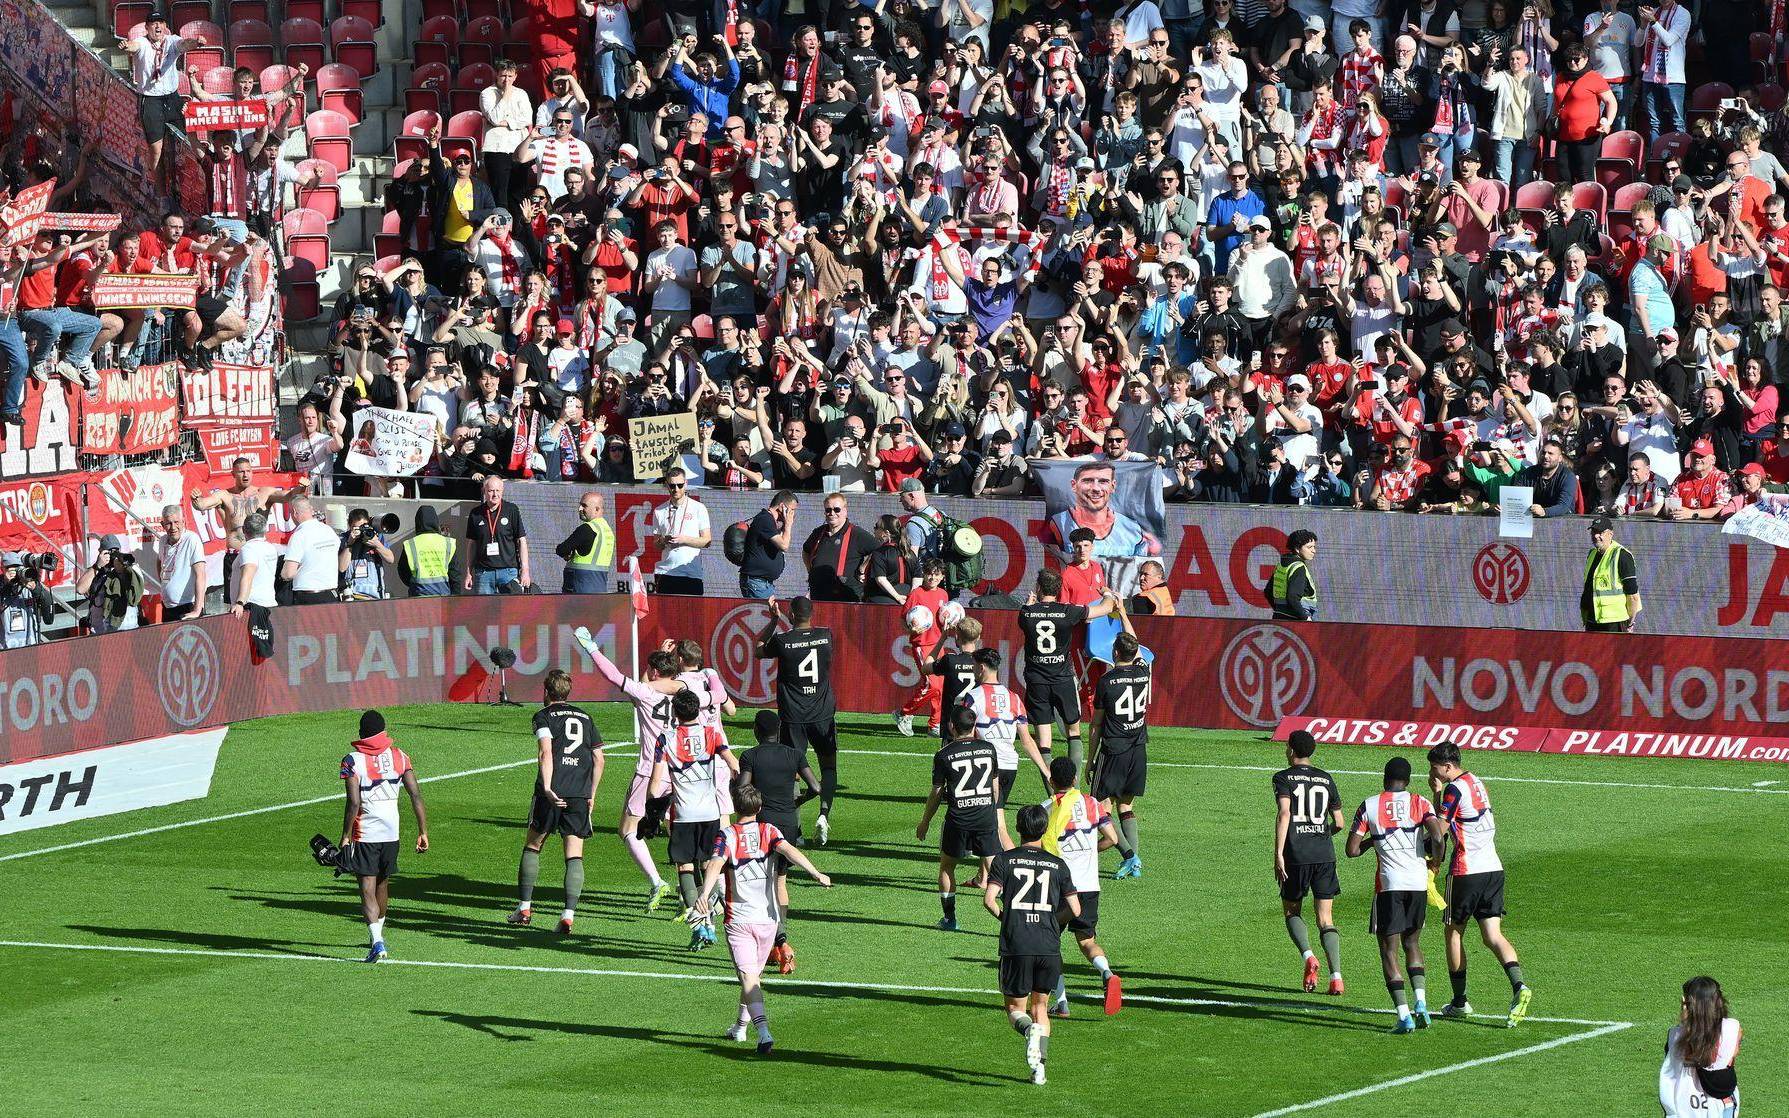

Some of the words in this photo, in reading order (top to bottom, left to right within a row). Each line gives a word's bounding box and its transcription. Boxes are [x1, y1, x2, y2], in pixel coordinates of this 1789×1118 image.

[185, 116, 219, 127] IMMER
[244, 114, 265, 123] UNS
[97, 293, 134, 305] IMMER
[137, 292, 195, 305] ANWESEND
[185, 369, 272, 417] COLEGIO
[85, 411, 118, 449] RED
[211, 430, 229, 447] LOVE
[633, 417, 680, 437] JAMAL
[636, 446, 667, 459] Trikot
[288, 623, 615, 687] PLATINUM
[1035, 620, 1057, 655] 8
[798, 648, 819, 684] 4
[802, 685, 817, 695] TAH
[1115, 683, 1149, 721] 44
[1412, 655, 1600, 717] NOVO
[563, 717, 583, 754] 9
[1304, 717, 1389, 745] CATS
[1390, 721, 1419, 746] &
[1421, 724, 1519, 750] DOGS
[562, 756, 579, 766] KANE
[951, 757, 993, 798] 22
[1292, 783, 1329, 825] 10
[1011, 867, 1053, 912] 21
[1025, 913, 1040, 923] ITO
[1689, 1093, 1709, 1110] 02
